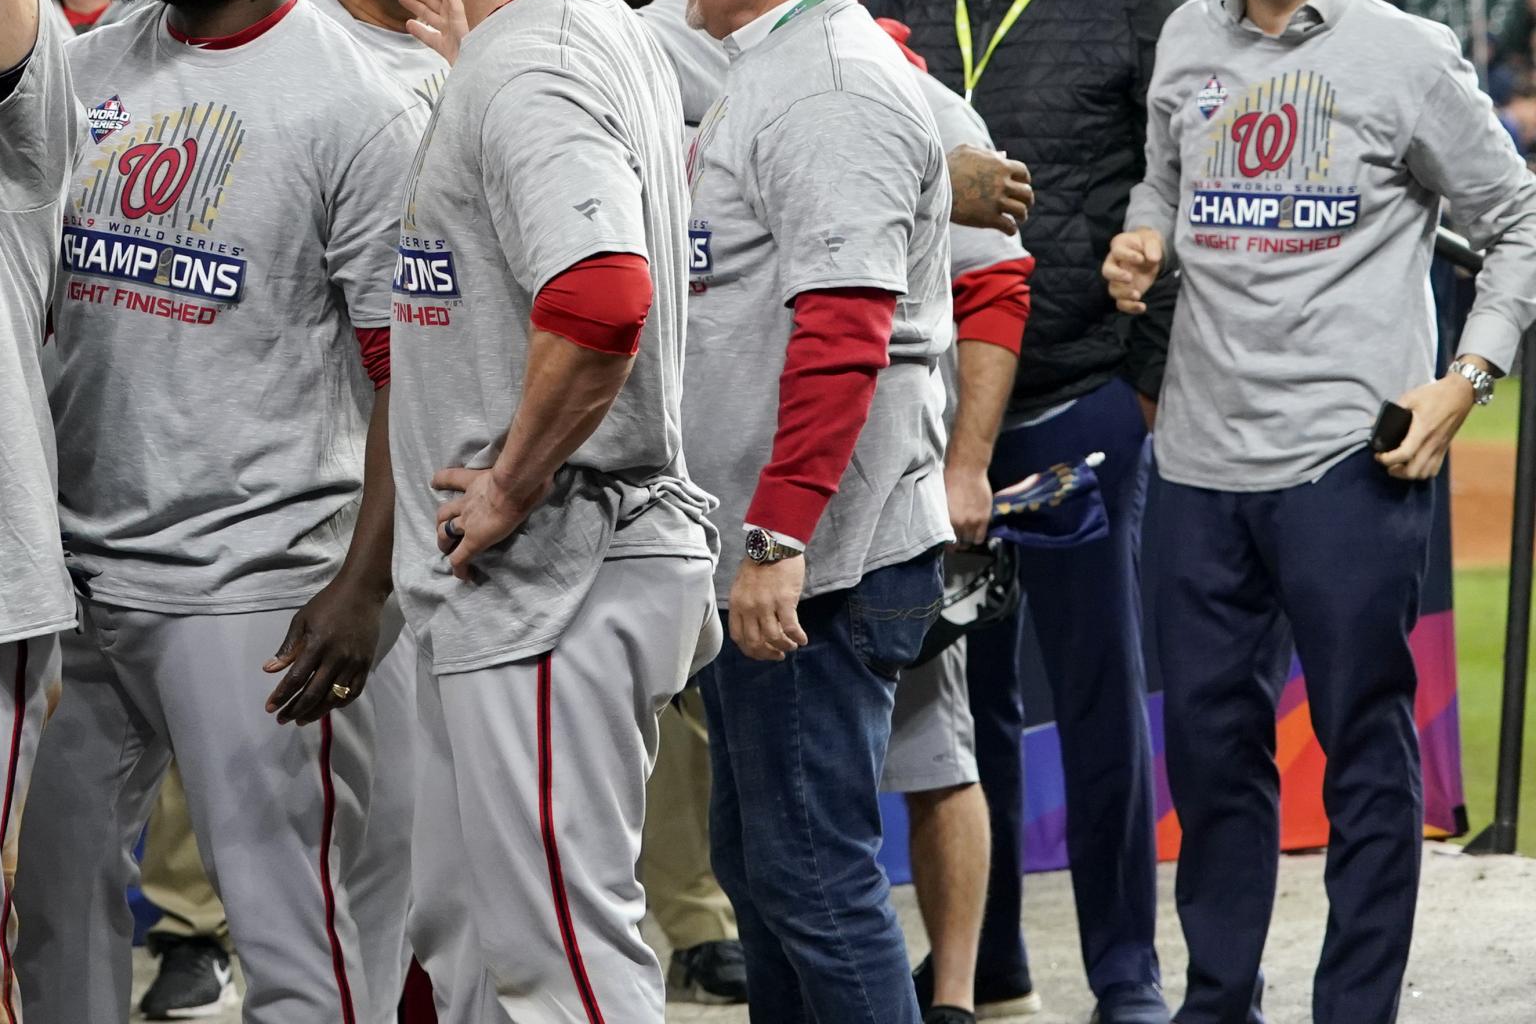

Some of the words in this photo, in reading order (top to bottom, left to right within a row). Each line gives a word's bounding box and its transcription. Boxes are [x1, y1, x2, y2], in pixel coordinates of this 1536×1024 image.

[87, 106, 131, 123] WORLD
[1231, 102, 1298, 179] W
[118, 137, 199, 220] W
[1232, 182, 1283, 192] WORLD
[109, 221, 165, 241] WORLD
[175, 234, 241, 256] SERIES
[1246, 234, 1341, 254] FINISHED
[113, 288, 217, 325] FINISHED
